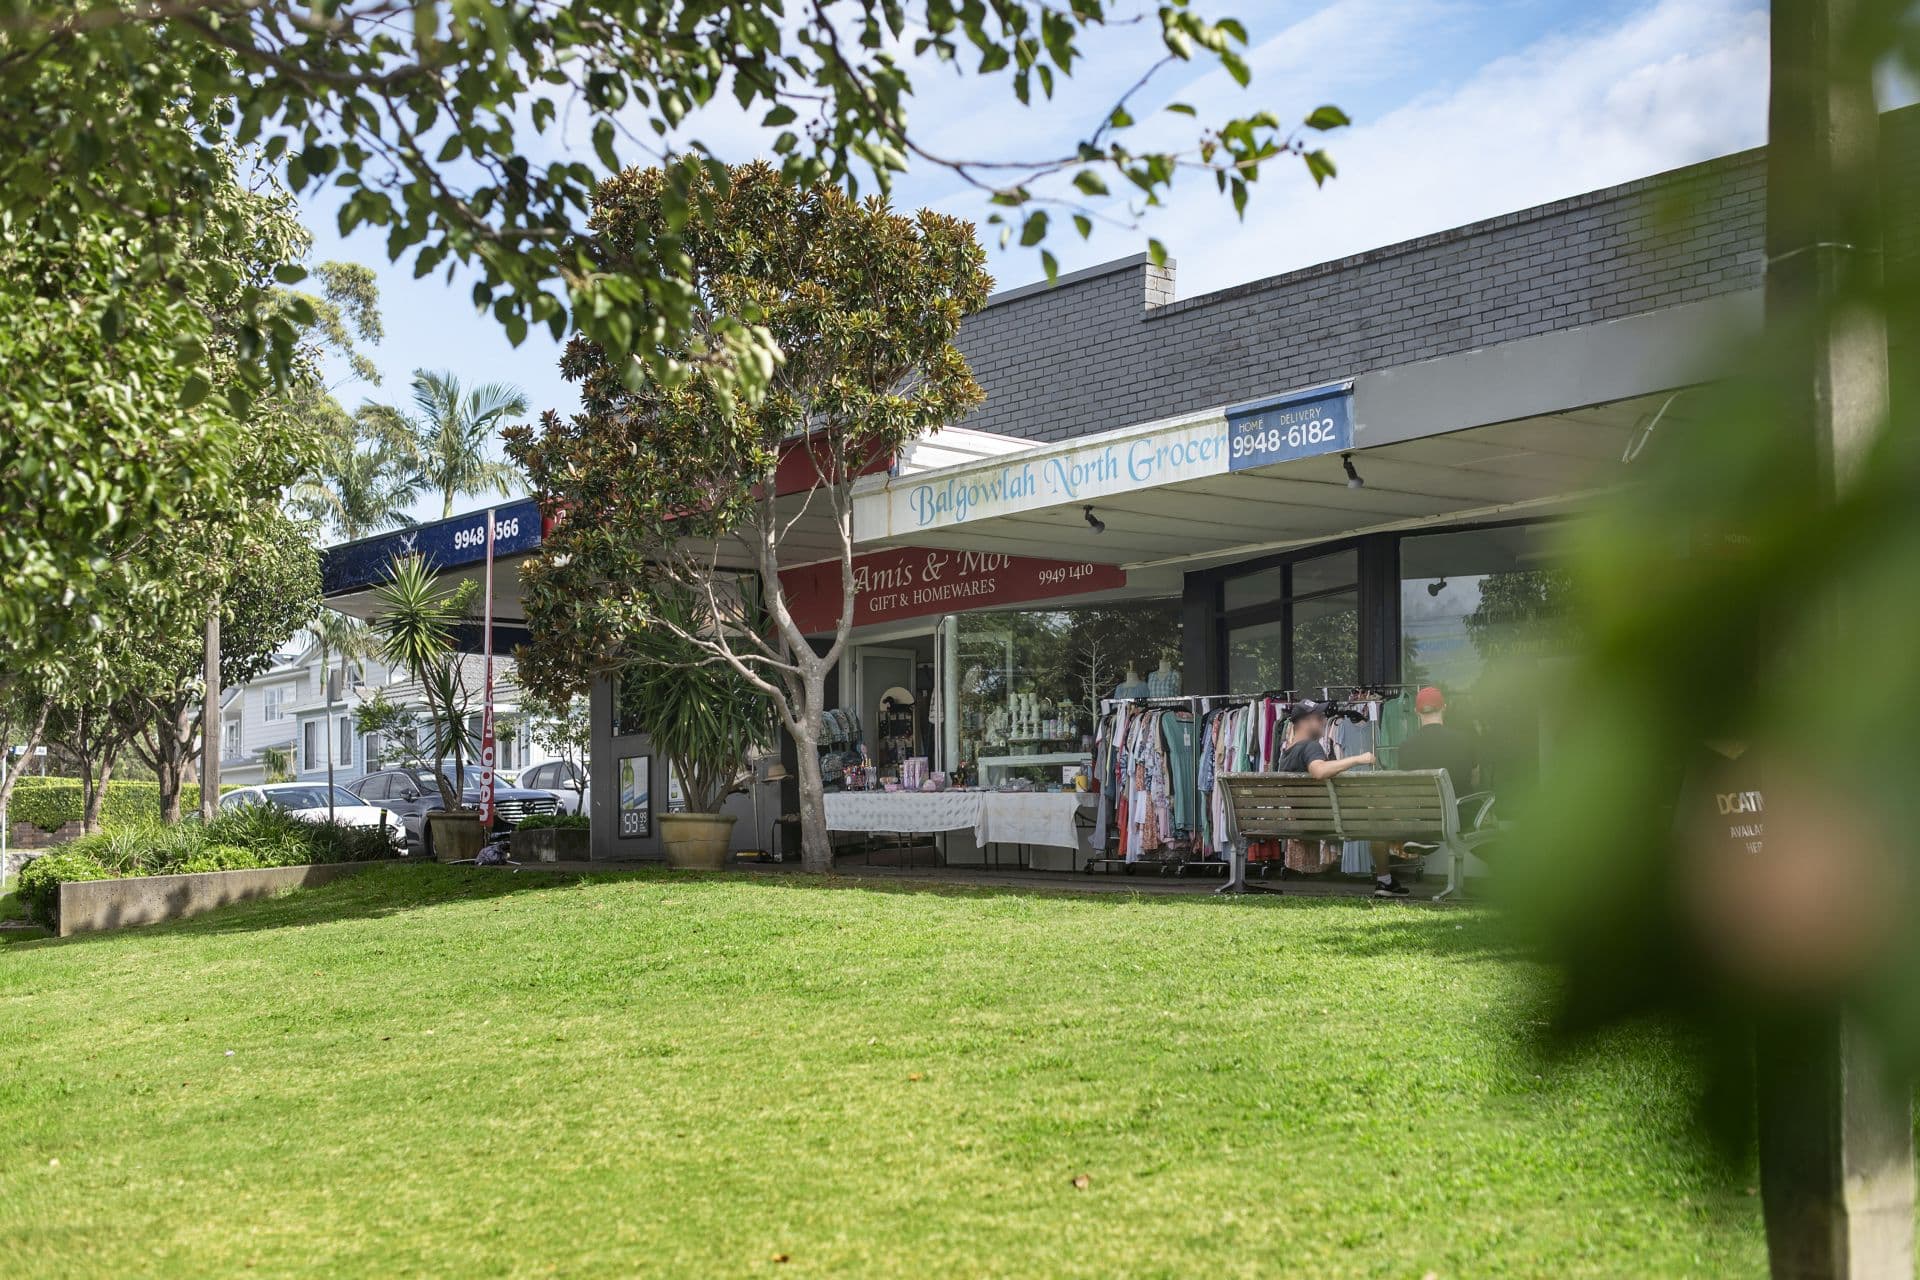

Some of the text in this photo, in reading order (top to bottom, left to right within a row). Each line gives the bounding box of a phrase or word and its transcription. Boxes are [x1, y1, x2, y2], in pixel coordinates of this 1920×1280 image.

[1239, 407, 1322, 433] HOME DELIVERY
[1232, 418, 1336, 458] 9948-6182
[910, 434, 1227, 526] Balgowlah North Grocer
[454, 526, 485, 550] 9948
[853, 558, 913, 593] Amis
[922, 552, 949, 582] &
[1038, 563, 1094, 586] 9949 1410
[869, 578, 996, 612] GIFT & HOMEWARES
